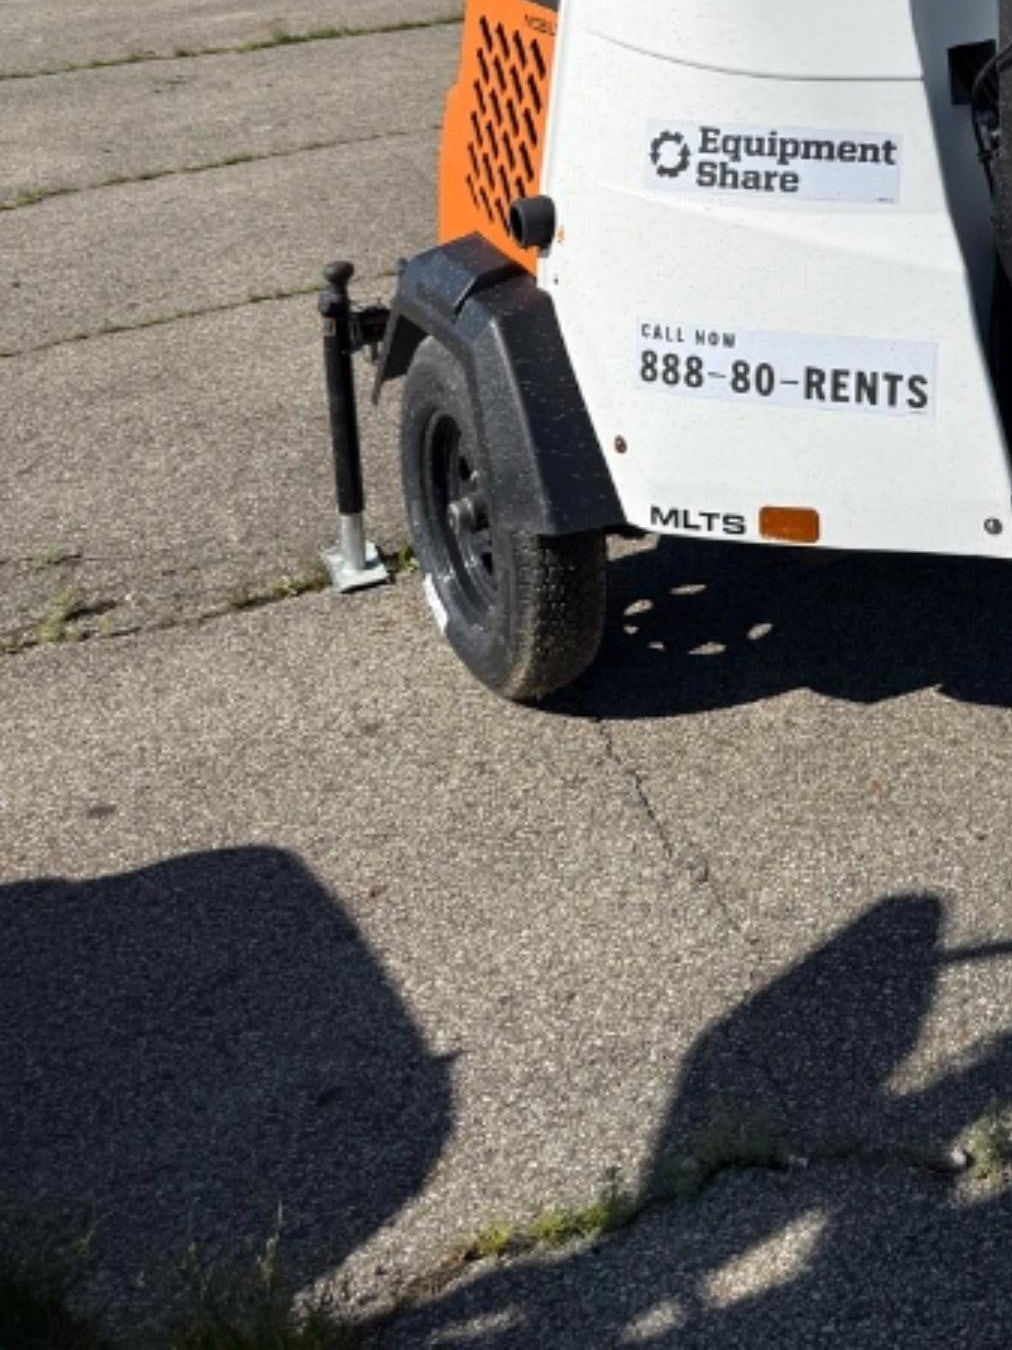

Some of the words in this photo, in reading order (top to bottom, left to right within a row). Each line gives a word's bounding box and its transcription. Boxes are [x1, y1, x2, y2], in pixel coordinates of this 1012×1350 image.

[699, 125, 897, 165] Equipment
[695, 161, 800, 193] Share
[640, 323, 686, 343] CALL
[695, 329, 737, 349] NOW
[640, 349, 930, 409] 888-80-RENTS
[650, 504, 746, 535] MLTS
